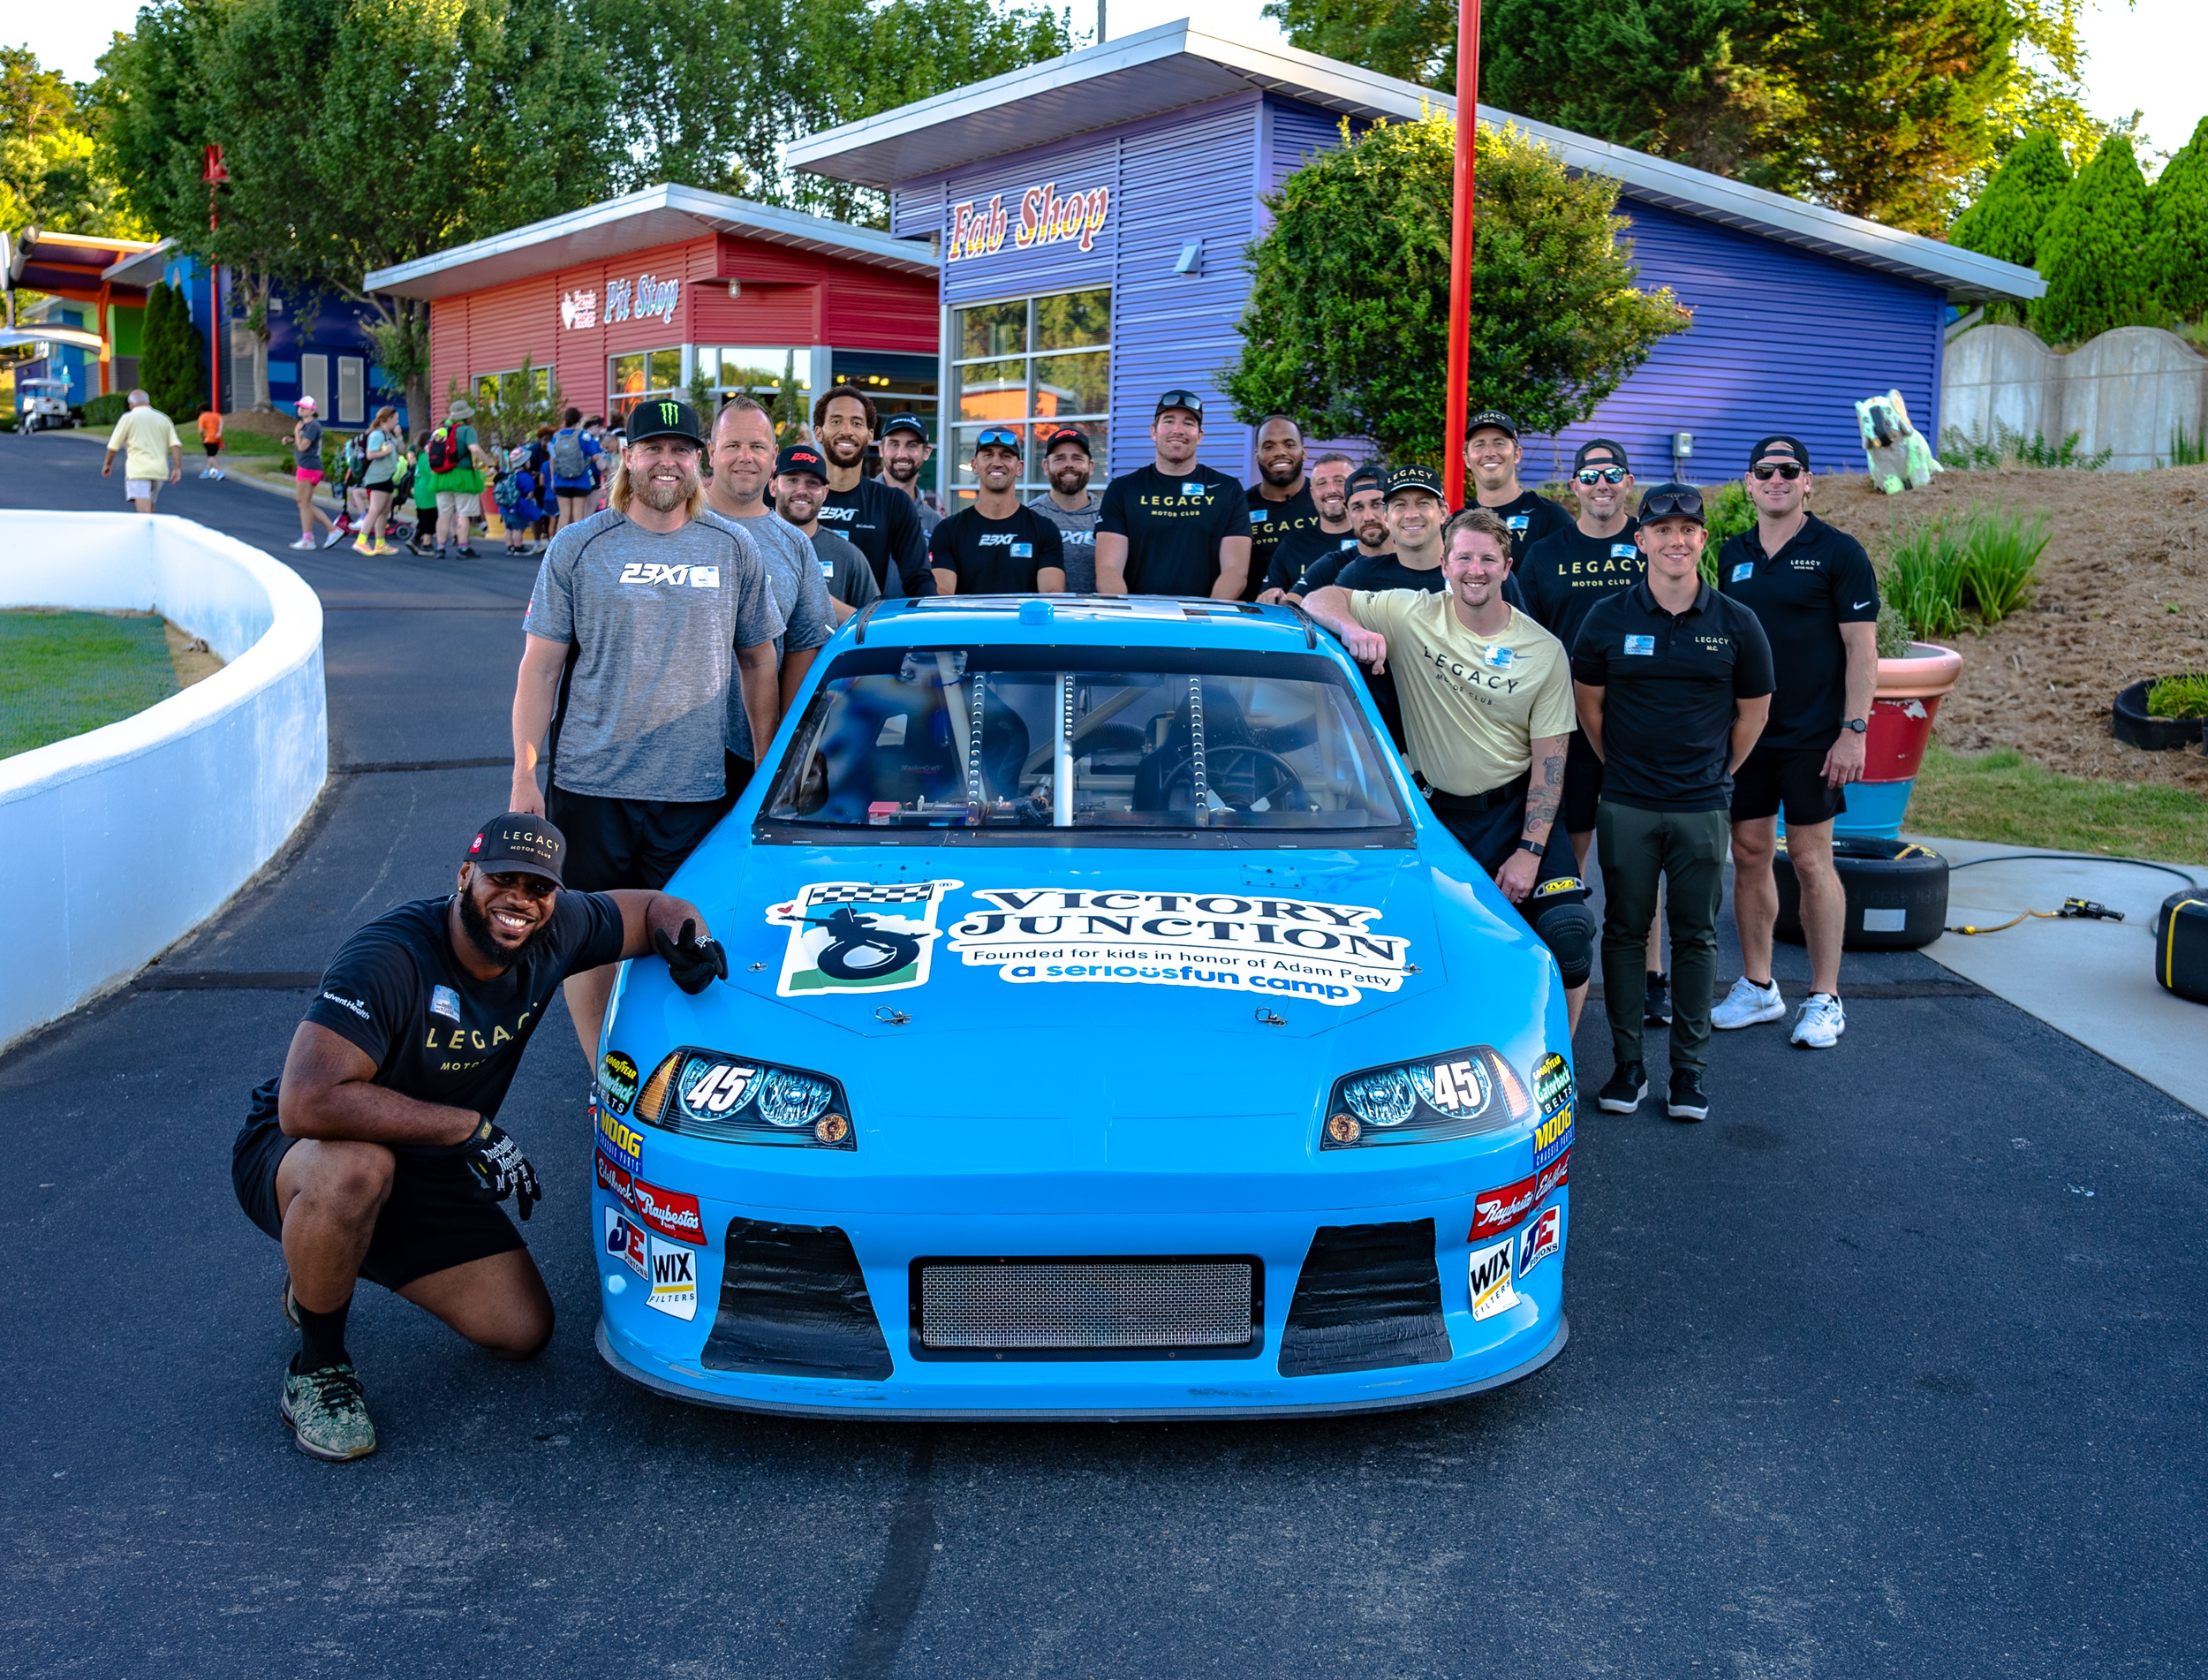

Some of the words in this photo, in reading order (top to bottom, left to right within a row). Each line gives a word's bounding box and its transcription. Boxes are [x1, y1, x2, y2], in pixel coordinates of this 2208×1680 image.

[948, 193, 1008, 261] Fab
[1016, 182, 1109, 252] Shop
[604, 278, 631, 324] Pit
[634, 274, 679, 324] Stop
[1387, 468, 1433, 483] LEGACY
[1140, 496, 1214, 506] LEGACY
[1251, 517, 1319, 534] EGACY
[1558, 560, 1646, 575] LEGACY
[1695, 636, 1729, 645] LEGACY
[1423, 646, 1518, 694] LEGACY
[1468, 692, 1493, 706] CLUB
[503, 830, 560, 851] LEGACY
[537, 850, 551, 859] CLUB
[984, 890, 1372, 927] VICTORY
[960, 912, 1399, 961] JUNCTION
[973, 949, 1063, 961] Founded
[1070, 949, 1100, 958] for
[1107, 949, 1148, 960] kids
[1154, 950, 1172, 960] in
[1180, 951, 1241, 966] honor
[1247, 957, 1267, 968] of
[1274, 960, 1333, 978] Adam
[1341, 967, 1392, 987] Petty
[1011, 965, 1036, 978] a
[1249, 975, 1350, 999] camp
[598, 1062, 636, 1104] Gatorback
[606, 1054, 638, 1080] GOODYEAR
[1532, 1055, 1561, 1081] GOODYEAR
[1533, 1064, 1571, 1104] Gatorback
[685, 1064, 757, 1112] 45
[1433, 1060, 1481, 1111] 45
[1544, 1084, 1573, 1114] BELTS
[600, 1107, 644, 1159] MOOG
[1534, 1101, 1572, 1154] MOOG
[619, 1151, 639, 1172] PARTS
[1537, 1141, 1559, 1167] CHASSIS
[598, 1157, 634, 1204] Edelbrock
[635, 1187, 699, 1230] Raybestos
[1476, 1191, 1534, 1227] Raybestos
[608, 1215, 646, 1267] JE
[1520, 1208, 1557, 1275] JE
[1529, 1242, 1558, 1268] PISTONS
[624, 1252, 648, 1279] PISTONS
[653, 1252, 693, 1283] WIX
[1471, 1239, 1512, 1297] WIX
[649, 1292, 695, 1303] FILTERS
[1474, 1279, 1510, 1319] FILTERS
